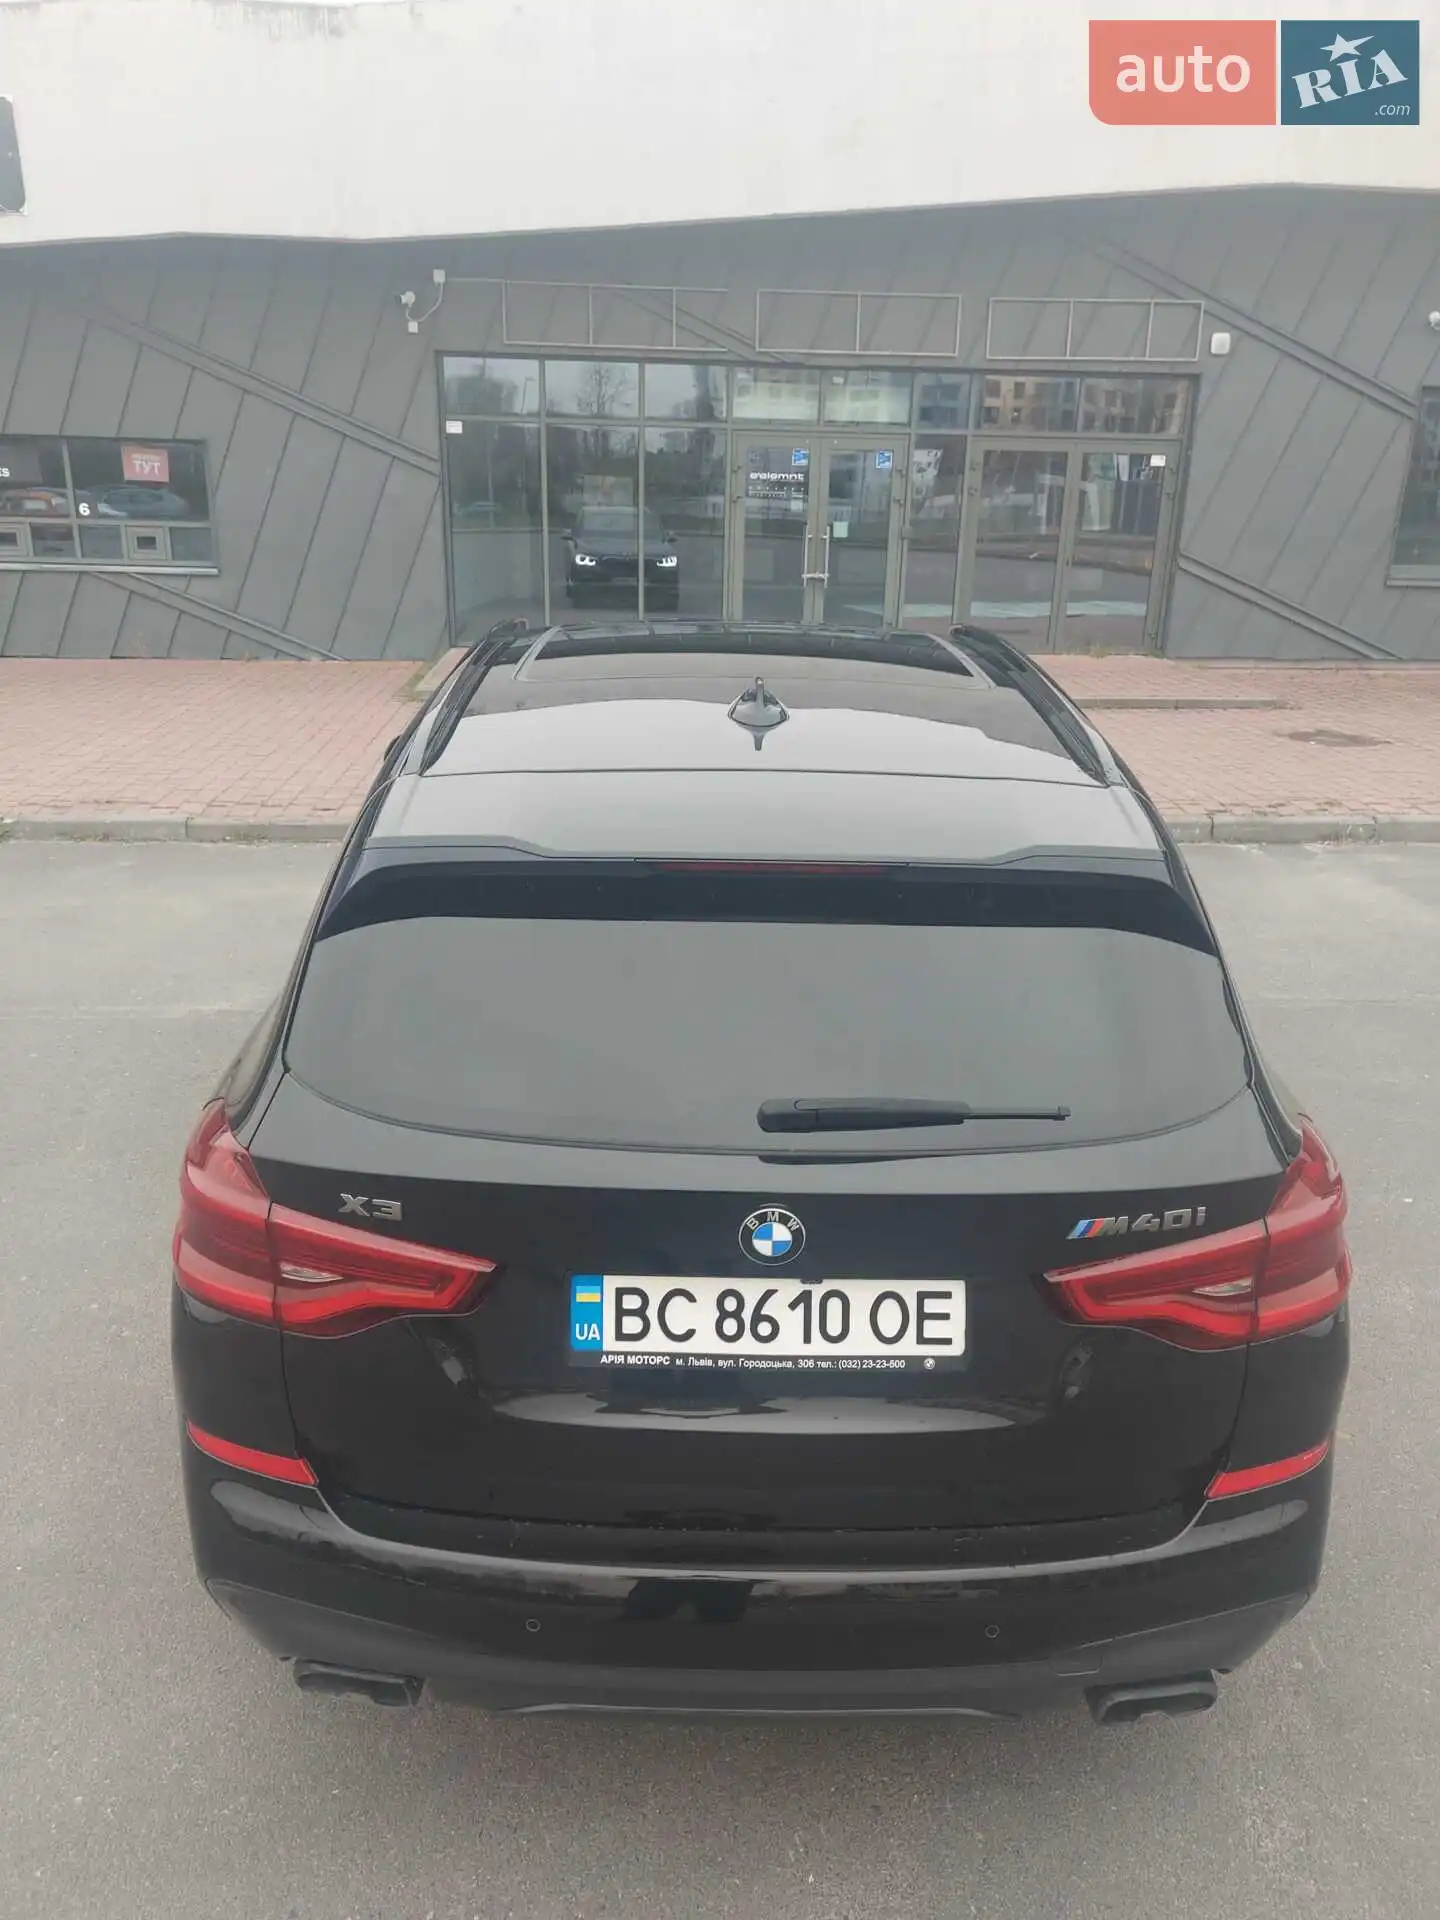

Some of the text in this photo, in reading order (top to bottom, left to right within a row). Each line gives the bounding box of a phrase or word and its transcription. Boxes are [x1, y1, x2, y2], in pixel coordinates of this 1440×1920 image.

[79, 502, 90, 516] 6
[338, 1193, 402, 1221] X3
[746, 1211, 800, 1231] BMW
[615, 1287, 953, 1345] BC 8610 OE
[575, 1322, 600, 1341] UA
[627, 1355, 671, 1365] МОТОРС
